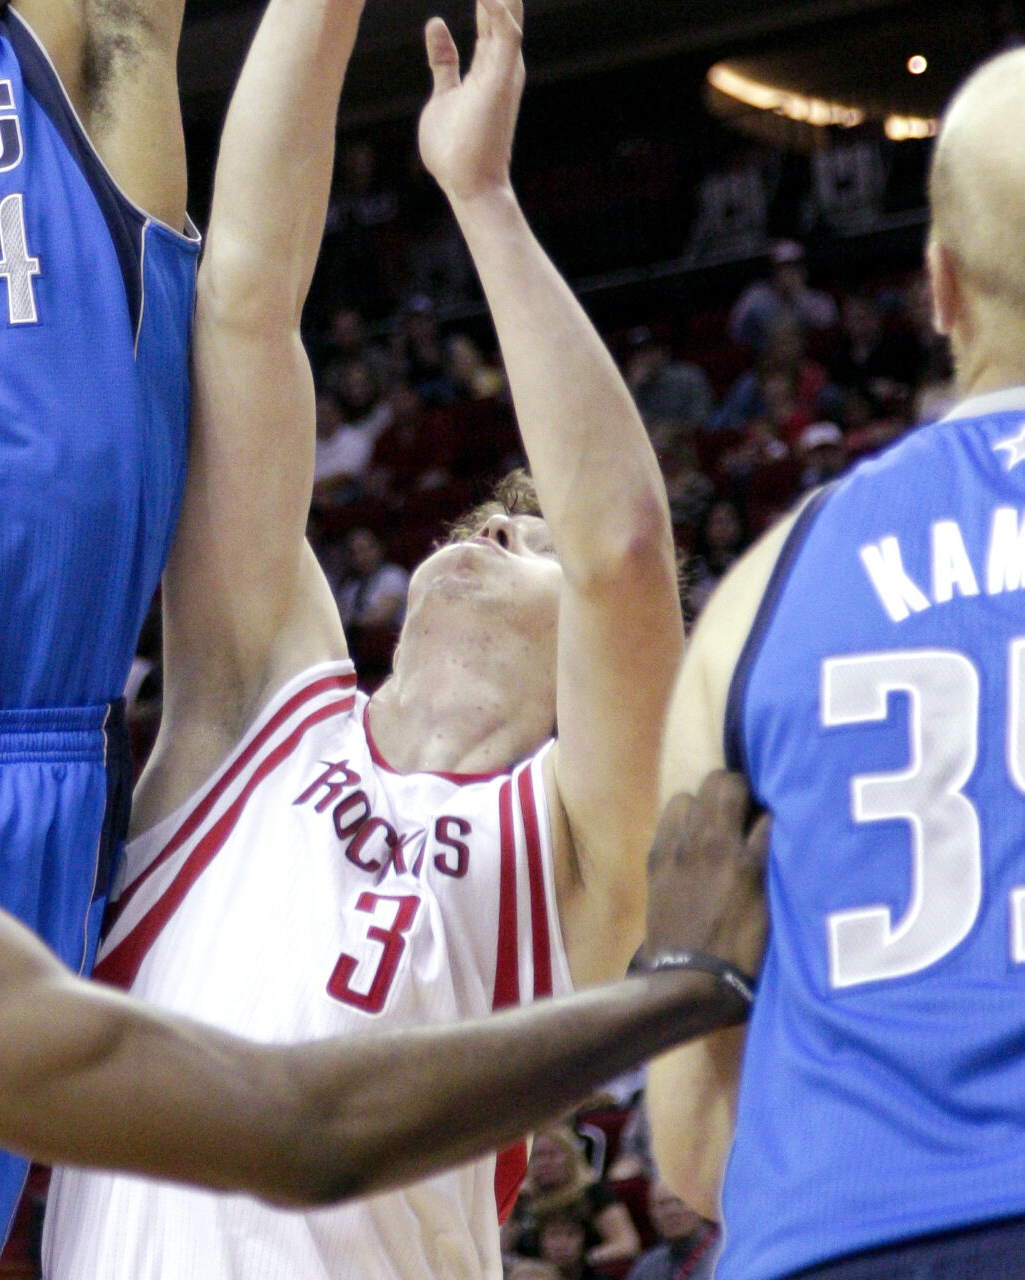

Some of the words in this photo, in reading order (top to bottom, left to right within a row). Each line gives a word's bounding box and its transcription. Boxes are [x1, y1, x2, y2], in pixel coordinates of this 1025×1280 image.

[292, 759, 472, 887] ROCKS
[821, 638, 1025, 988] 3
[326, 891, 421, 1014] 3
